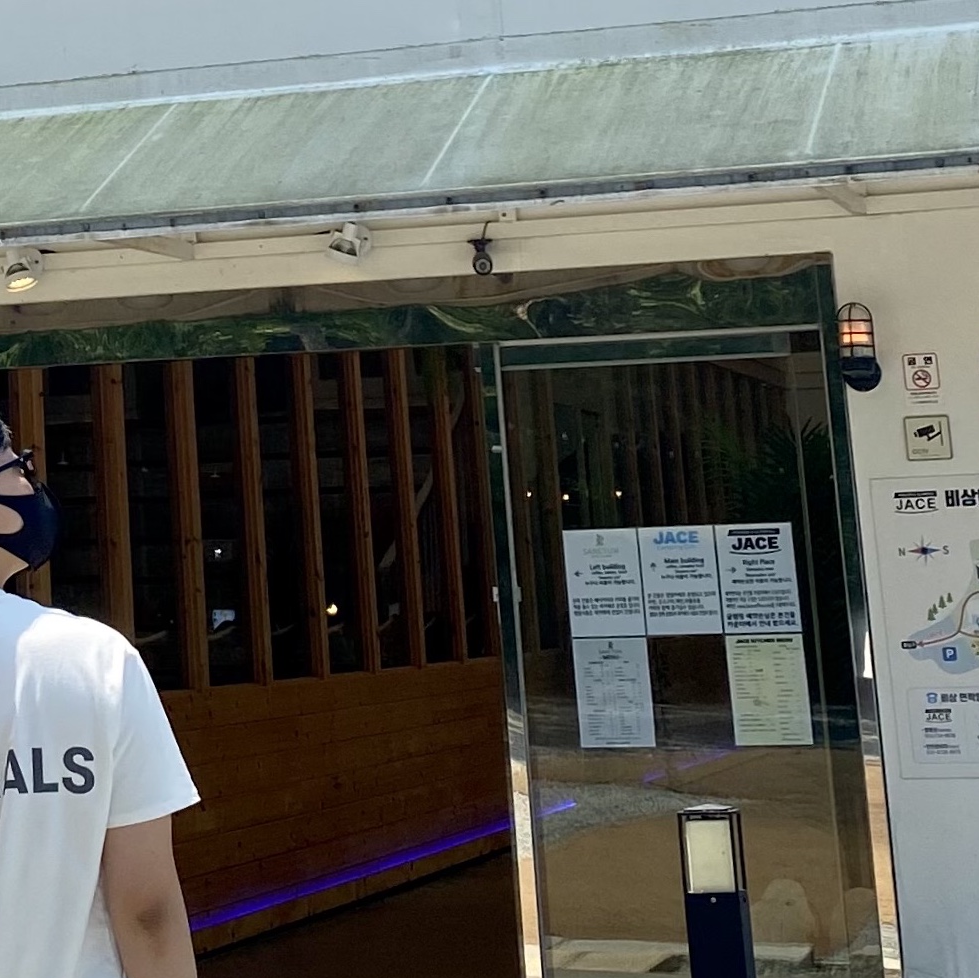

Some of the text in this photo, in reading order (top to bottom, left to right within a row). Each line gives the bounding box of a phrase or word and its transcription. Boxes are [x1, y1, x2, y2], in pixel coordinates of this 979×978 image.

[896, 498, 937, 511] JACE
[653, 530, 700, 545] JACE
[731, 536, 779, 550] JACE
[898, 547, 906, 556] N
[942, 545, 950, 555] S
[926, 713, 951, 721] JACE
